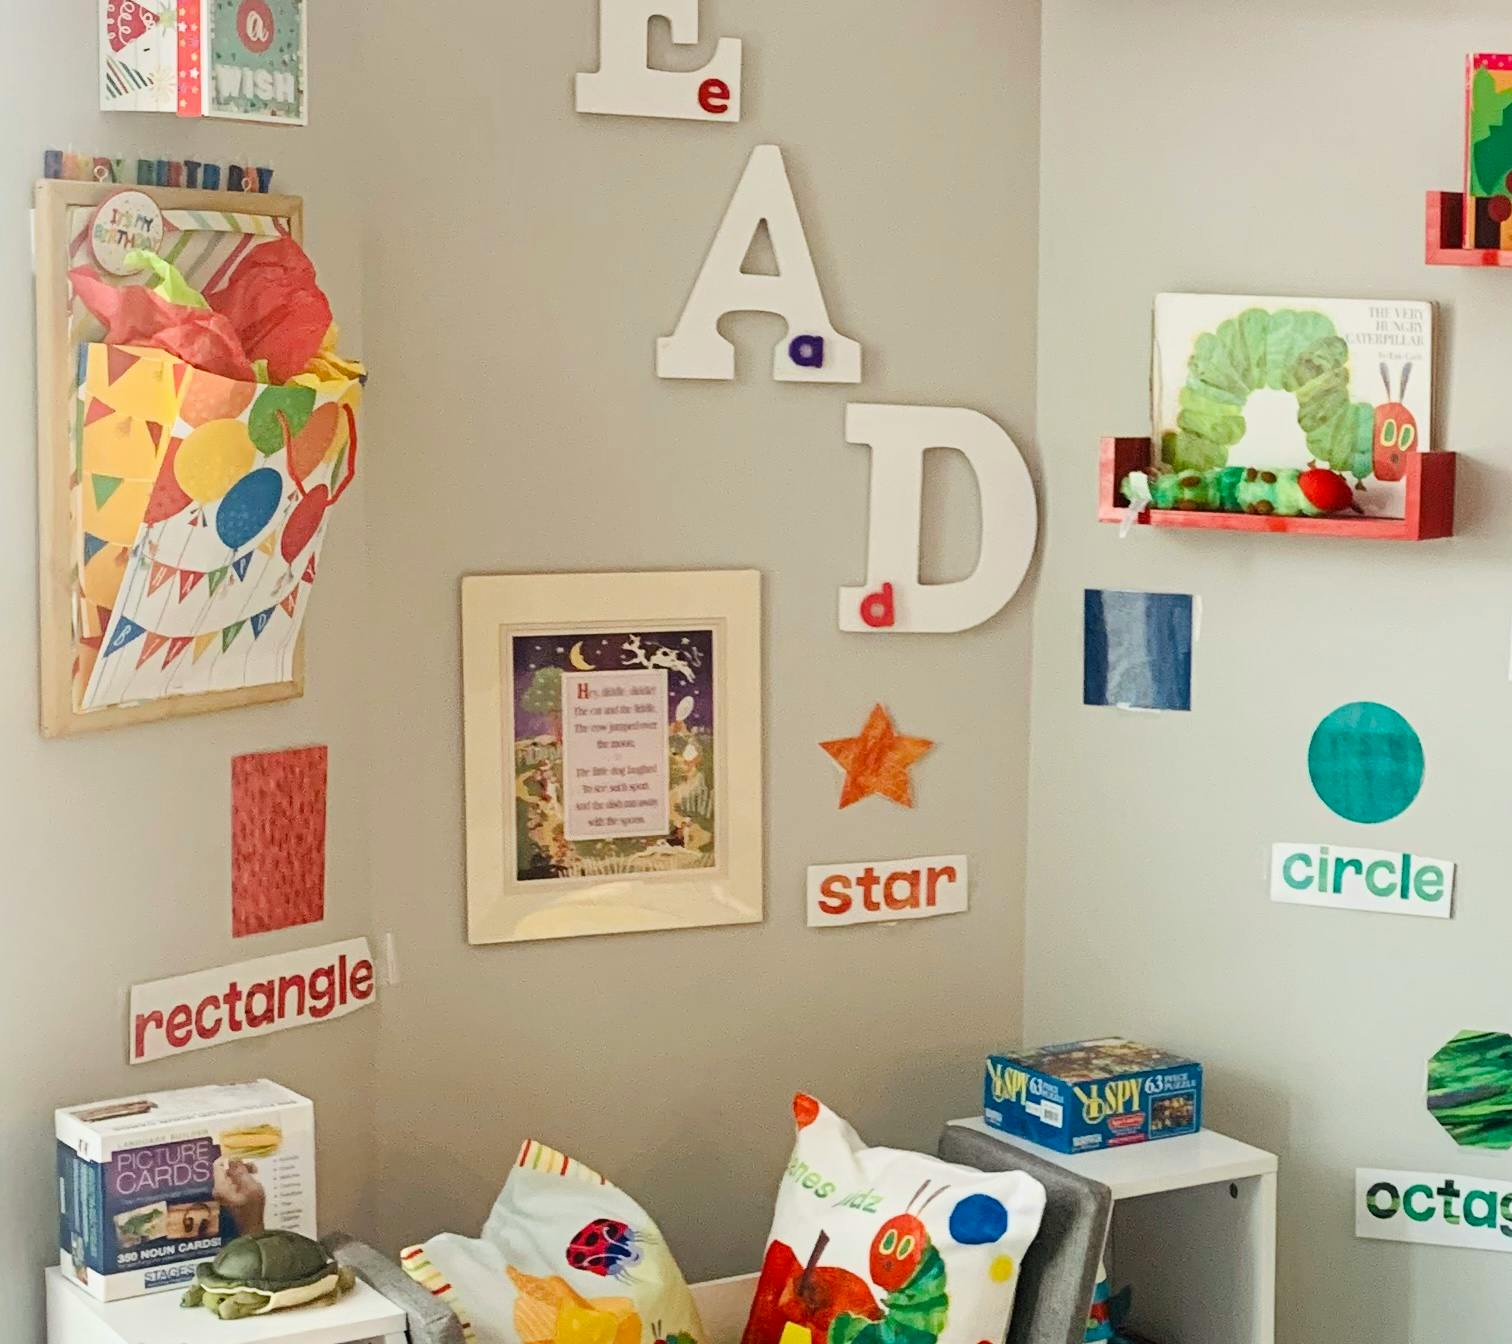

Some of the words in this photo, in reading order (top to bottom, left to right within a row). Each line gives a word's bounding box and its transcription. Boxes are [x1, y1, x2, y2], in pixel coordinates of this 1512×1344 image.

[246, 10, 269, 42] a
[216, 63, 295, 104] WISH
[1369, 307, 1390, 318] THE
[1345, 332, 1424, 345] CATERPILLAR
[817, 863, 957, 916] star
[1282, 846, 1445, 902] circle
[135, 954, 374, 1058] rectangle
[1004, 1067, 1030, 1105] SPY
[1104, 1078, 1142, 1114] SPY
[1144, 1074, 1163, 1094] 63
[117, 1141, 209, 1171] PICTURE
[116, 1160, 210, 1195] CARDS
[117, 1251, 138, 1265] 350
[140, 1244, 176, 1260] NOUN
